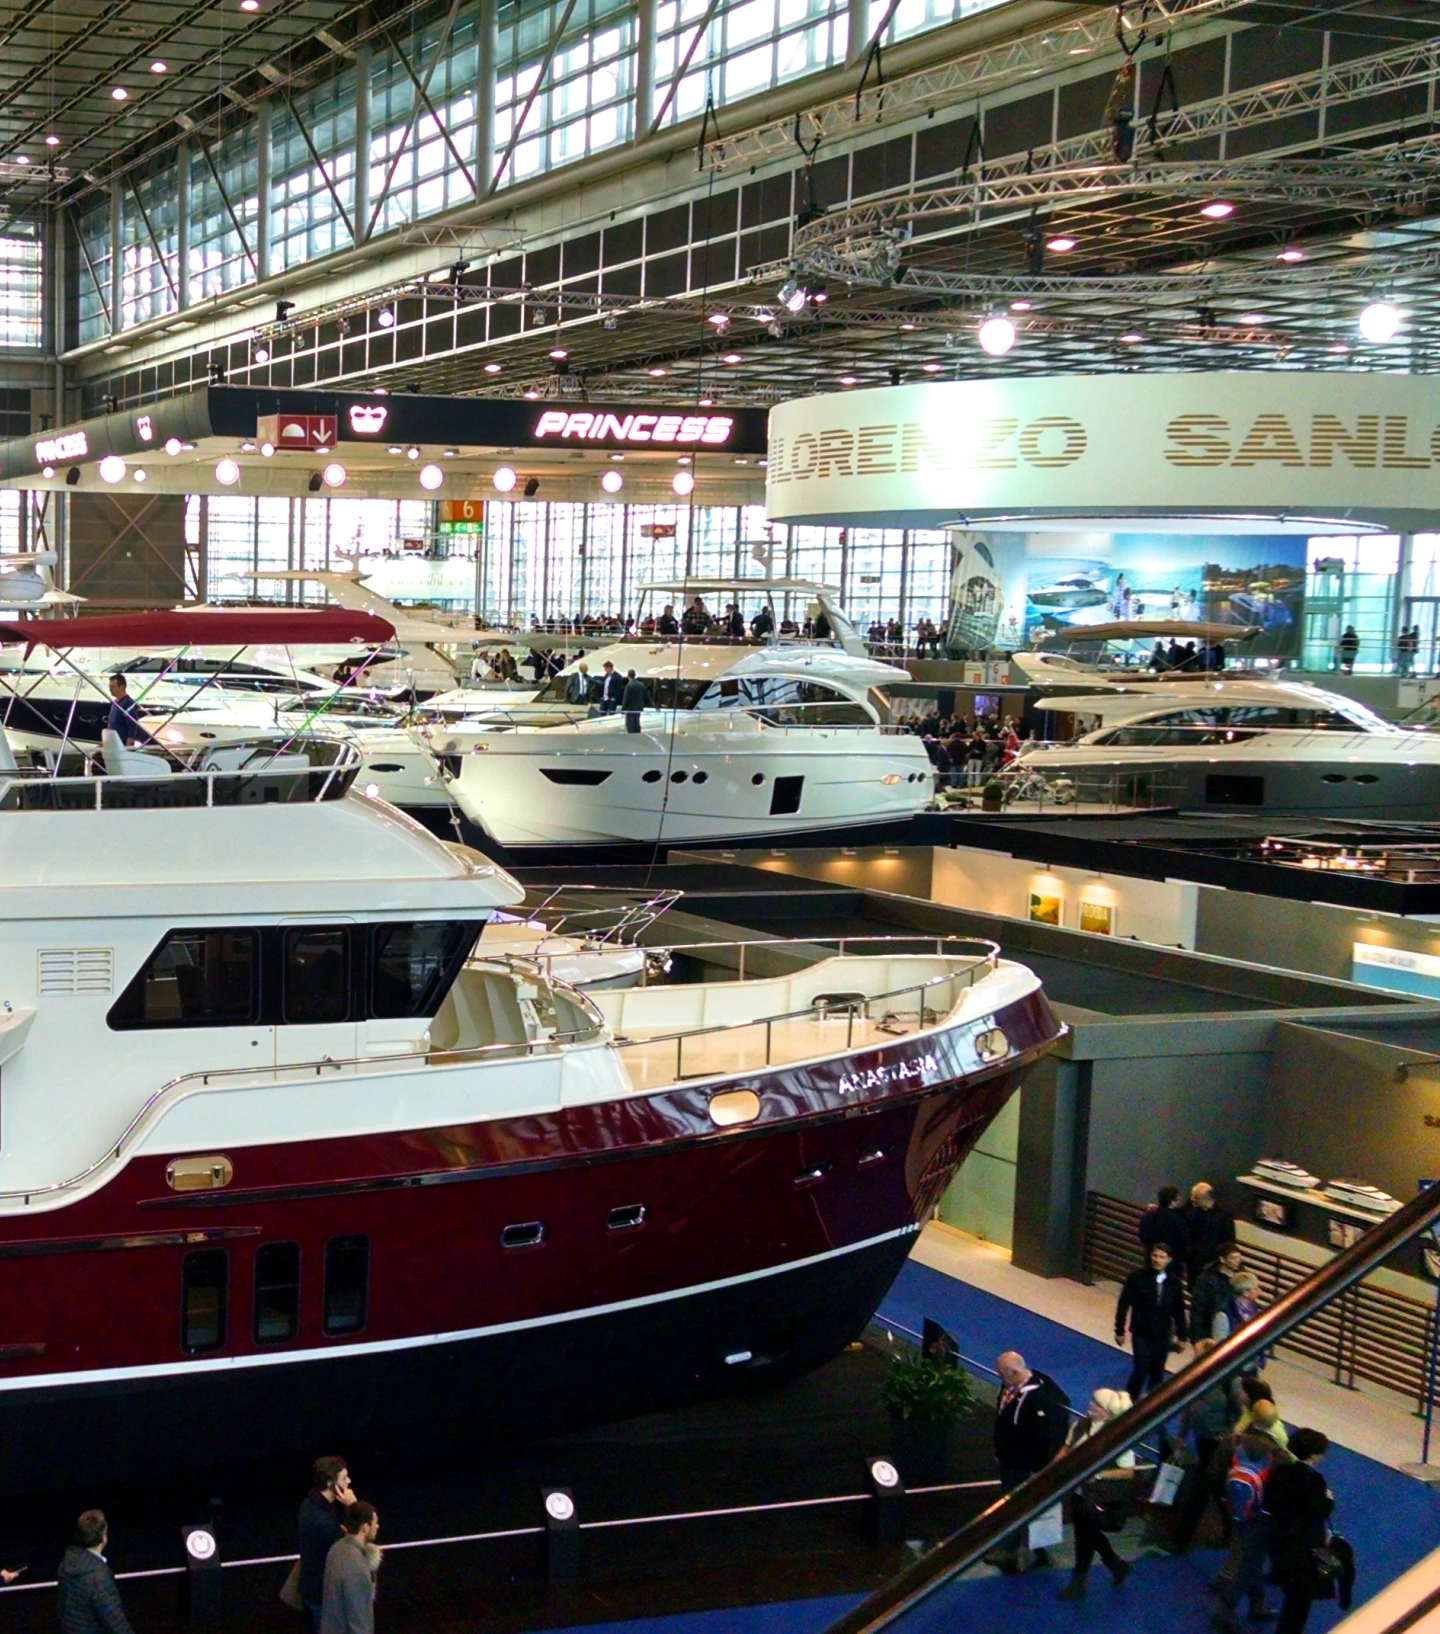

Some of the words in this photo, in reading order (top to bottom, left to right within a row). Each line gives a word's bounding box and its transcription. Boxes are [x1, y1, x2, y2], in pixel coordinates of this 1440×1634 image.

[535, 411, 734, 444] PRINCESS
[1163, 413, 1440, 469] SANL
[463, 501, 474, 519] 6
[838, 1054, 938, 1095] ANASTASIA
